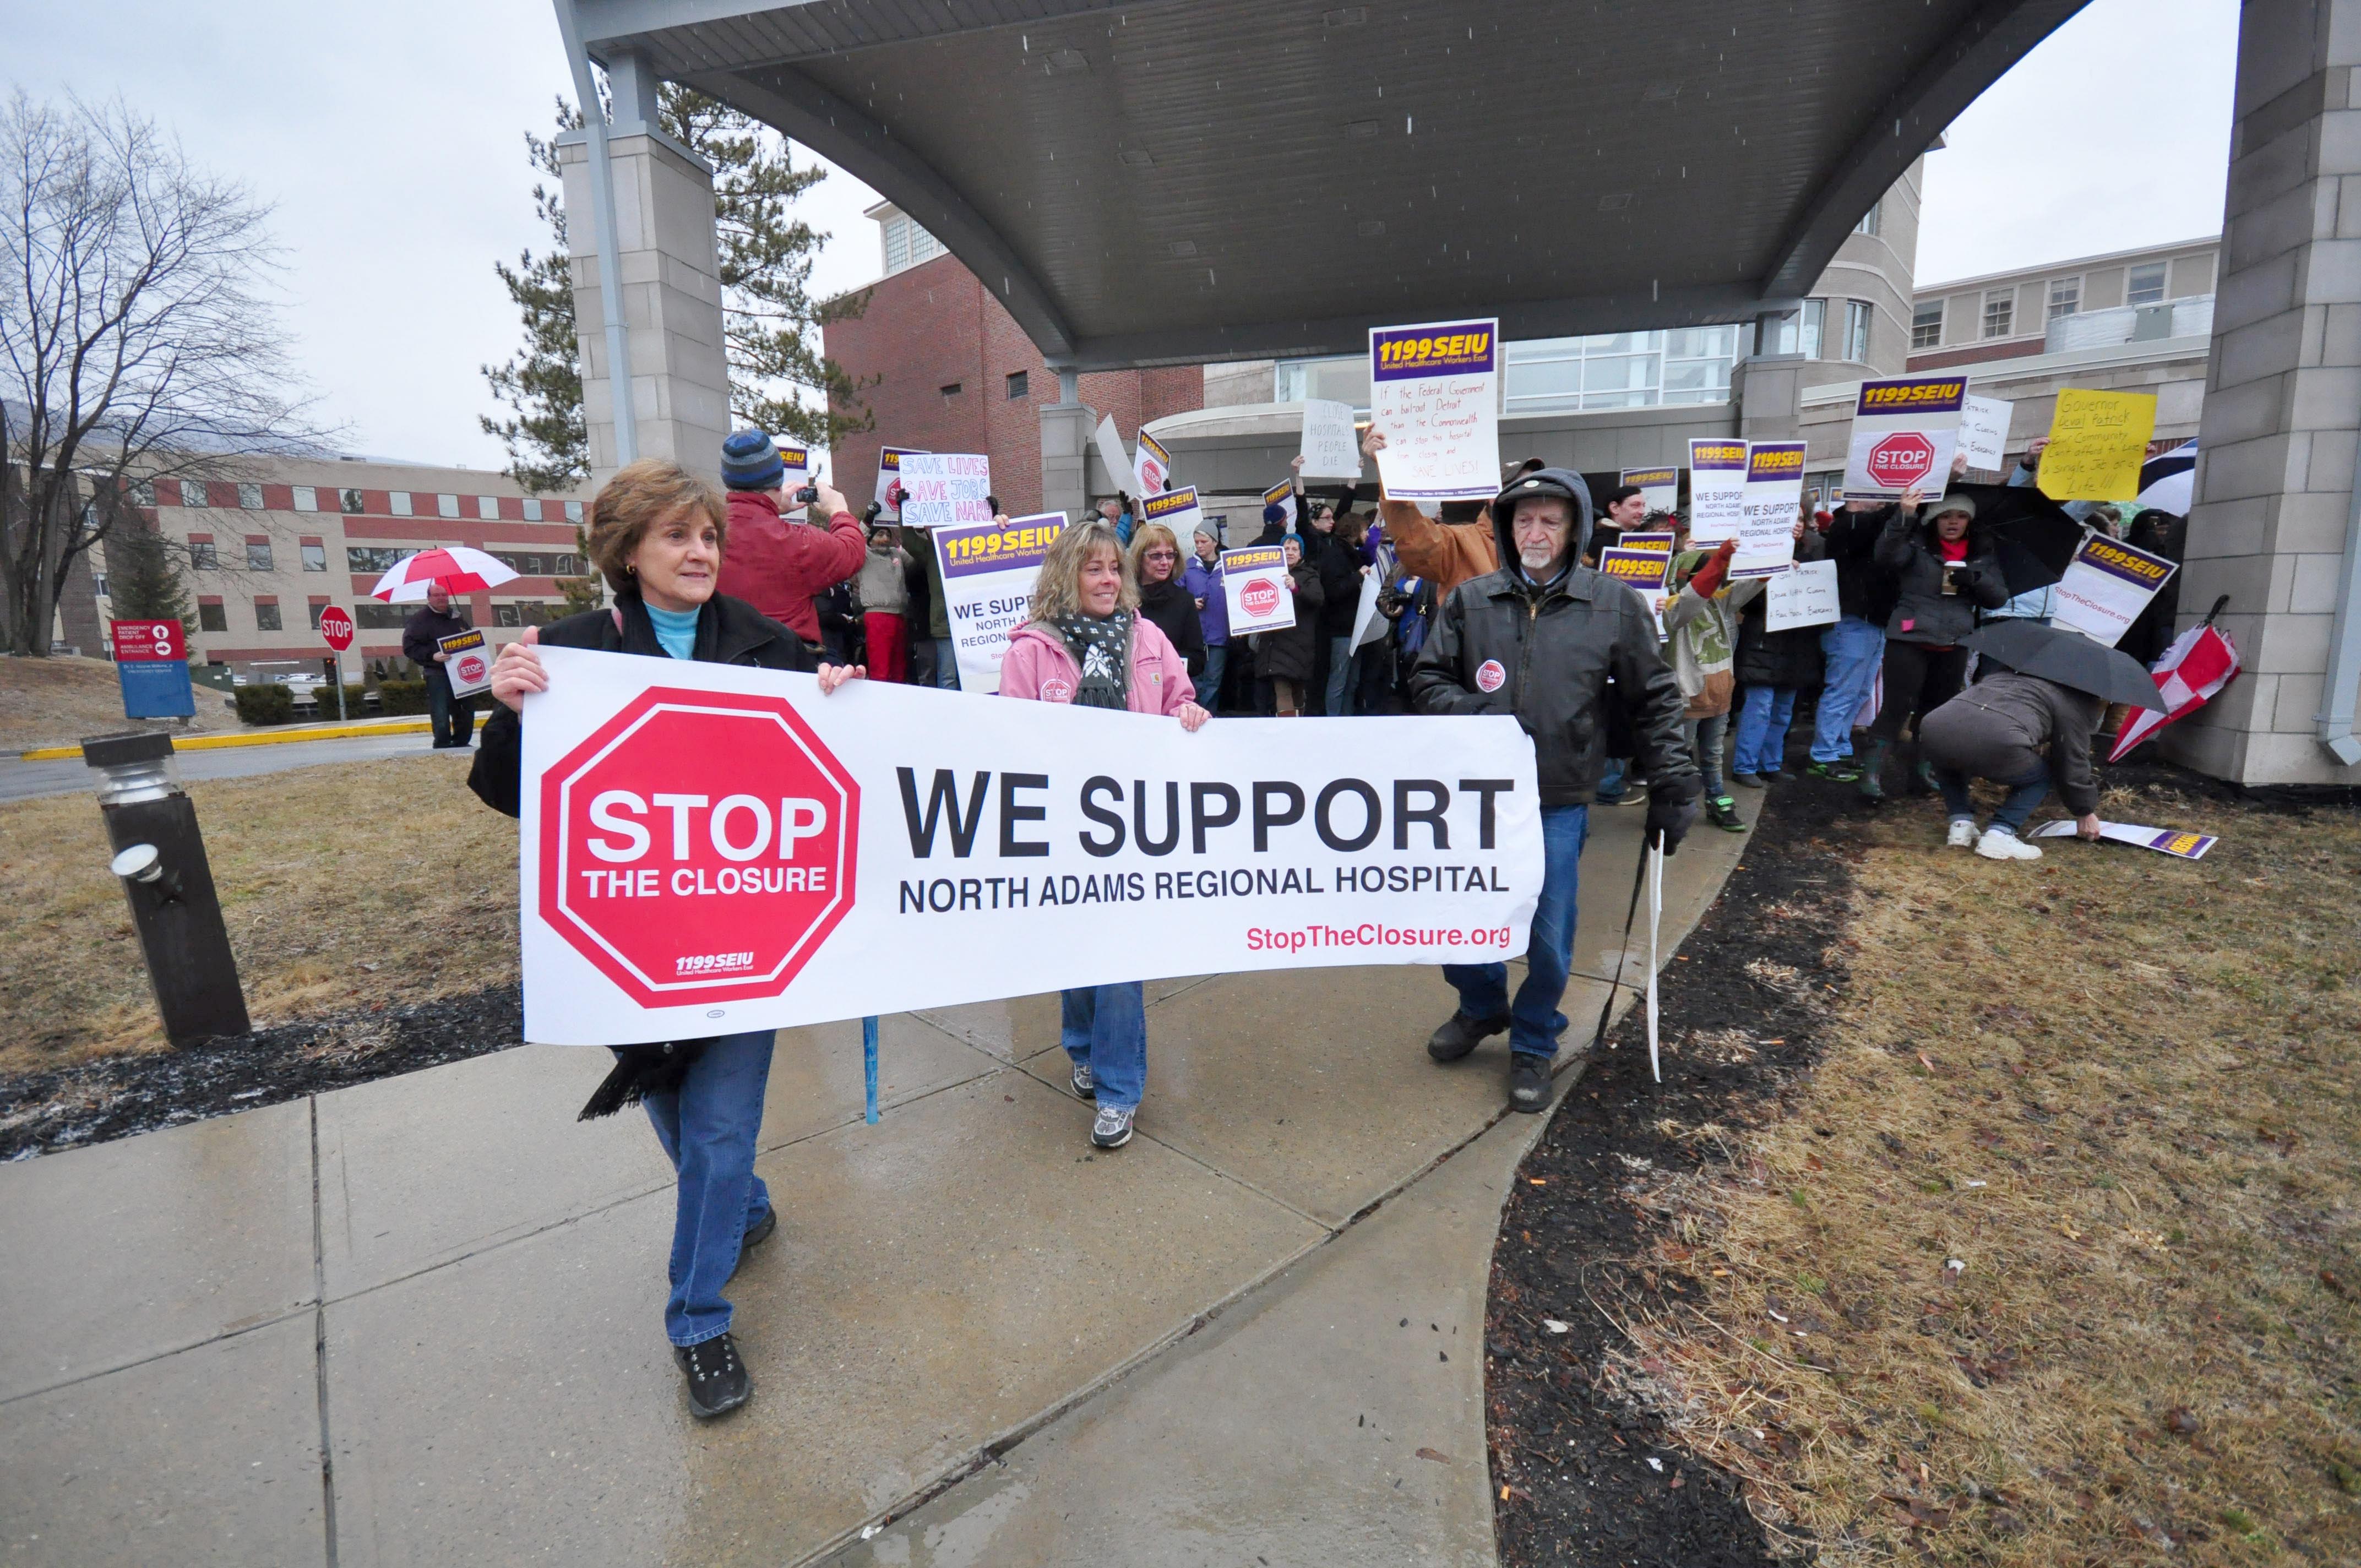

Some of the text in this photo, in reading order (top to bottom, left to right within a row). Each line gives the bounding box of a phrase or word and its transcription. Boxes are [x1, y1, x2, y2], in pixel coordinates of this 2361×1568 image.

[1379, 333, 1489, 362] 1199SEIU
[1381, 354, 1488, 370] United Healthcare Workers East
[1380, 381, 1485, 400] If the Federal Government
[1865, 383, 1961, 403] 1199SEIU
[1381, 408, 1392, 416] can
[1436, 398, 1462, 410] Detroit
[2061, 393, 2120, 412] Governor
[1323, 404, 1344, 420] CLOSE
[2058, 409, 2130, 427] Deval Patrick
[1416, 418, 1426, 427] the
[1415, 435, 1428, 447] stop
[2075, 431, 2128, 443] Community
[1141, 434, 1168, 464] 1199SEIU
[1318, 442, 1346, 452] PEOPLE
[1695, 447, 1745, 459] 1199SEIU
[1323, 456, 1340, 466] DIE
[1753, 451, 1804, 468] 1199SEIU
[1876, 450, 1927, 464] STOP
[2113, 460, 2126, 469] or
[2128, 461, 2135, 469] a
[902, 458, 943, 474] SAVE
[948, 458, 988, 476] LIVES
[1145, 466, 1160, 482] STOP
[1625, 471, 1674, 483] 1199SEIU
[904, 478, 987, 502] SAVE JOBS
[1695, 492, 1743, 502] WE SUPPO
[1146, 492, 1194, 512] 1199SEIU
[1744, 502, 1798, 516] WE SUPPORT
[905, 500, 992, 522] SAVE NARH
[1740, 527, 1772, 537] REGIONAL
[945, 525, 1060, 558] 1199SEIU
[949, 547, 1047, 567] United Healthcare Workers
[1226, 551, 1281, 567] 1199SEIU
[2088, 542, 2167, 578] 1199SEIU
[1606, 558, 1666, 575] 1199SEIU
[1244, 589, 1274, 602] STOP
[954, 595, 1035, 619] WE SUPP
[323, 619, 351, 638] STOP
[976, 617, 1016, 631] NORTH
[443, 633, 481, 649] 1199SEIU
[961, 633, 1009, 647] REGION
[460, 663, 482, 674] STOP
[1483, 669, 1500, 678] STOP
[896, 766, 1515, 858] WE SUPPORT
[586, 790, 827, 863] STOP
[581, 867, 826, 899] THE CLOSURE
[900, 865, 1510, 914] NORTH ADAMS REGIONAL HOSPITAL
[1247, 924, 1511, 954] StopTheClosure.org
[676, 951, 754, 970] 1199SEIU
